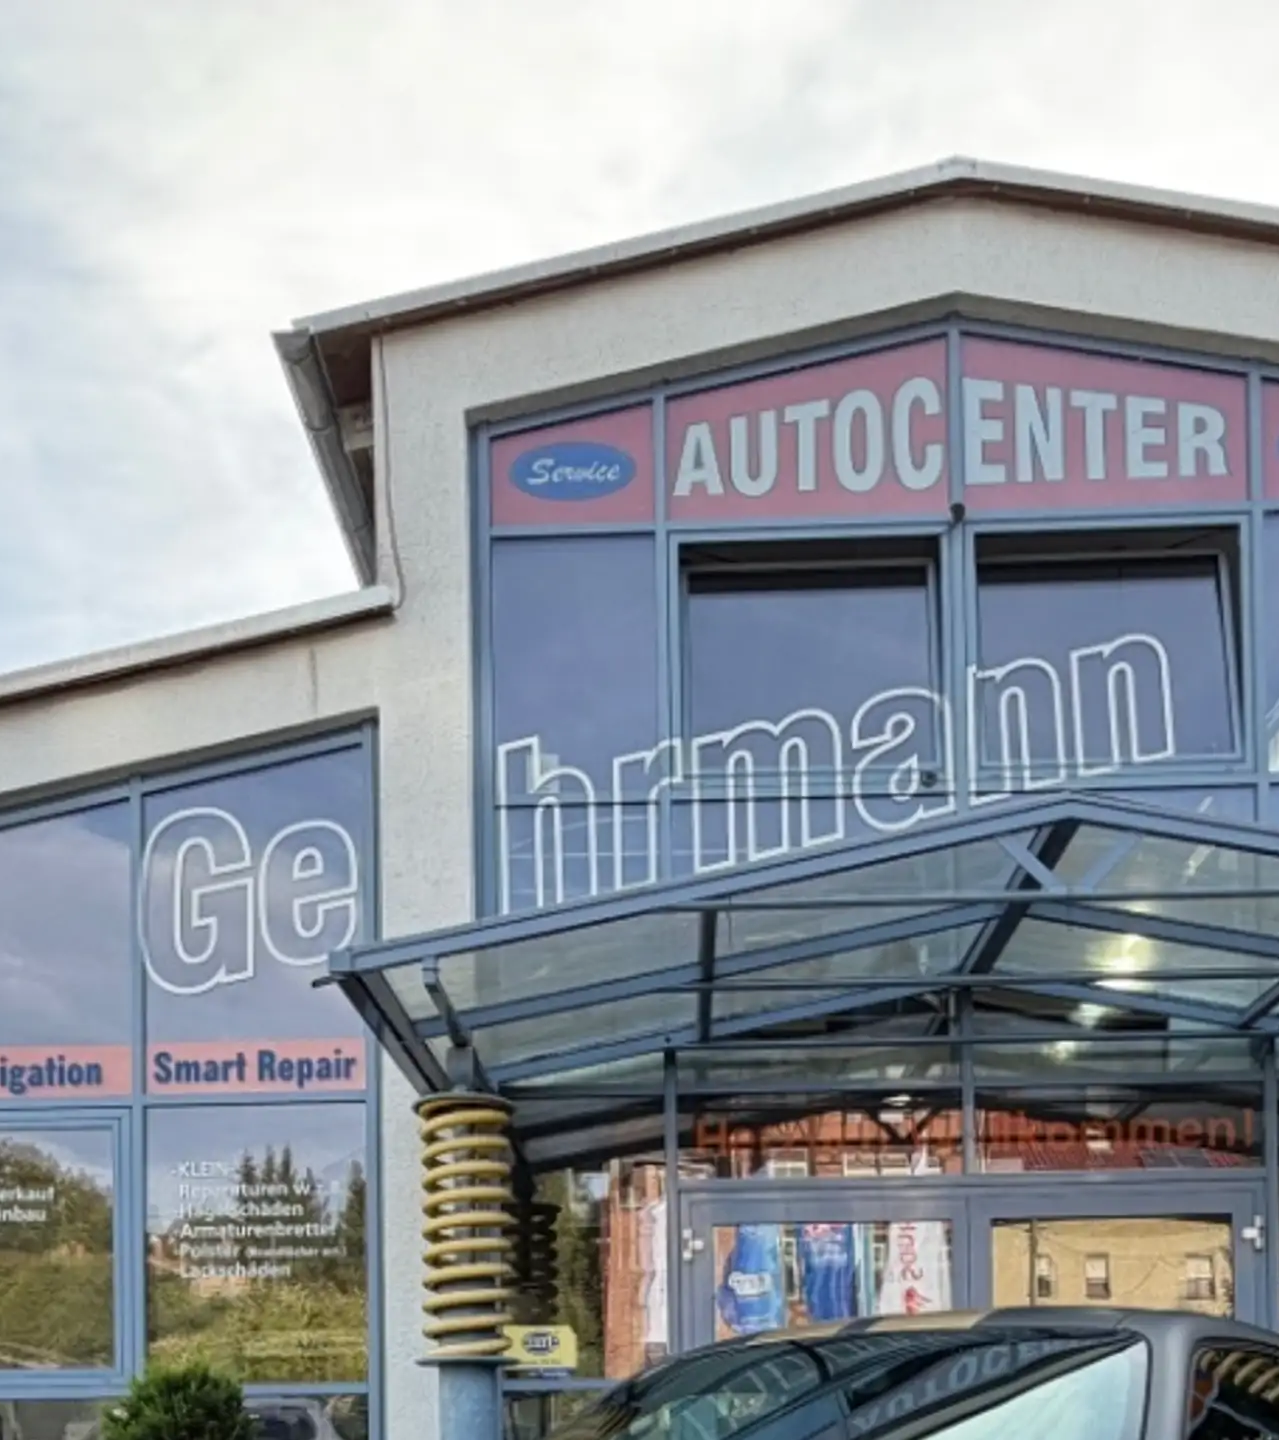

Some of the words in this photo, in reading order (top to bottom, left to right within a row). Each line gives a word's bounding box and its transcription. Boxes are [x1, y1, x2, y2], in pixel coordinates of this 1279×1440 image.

[672, 376, 1229, 497] AUTOCENTER
[526, 457, 621, 485] Service
[153, 1051, 248, 1085] Smart
[257, 1048, 357, 1089] Repair
